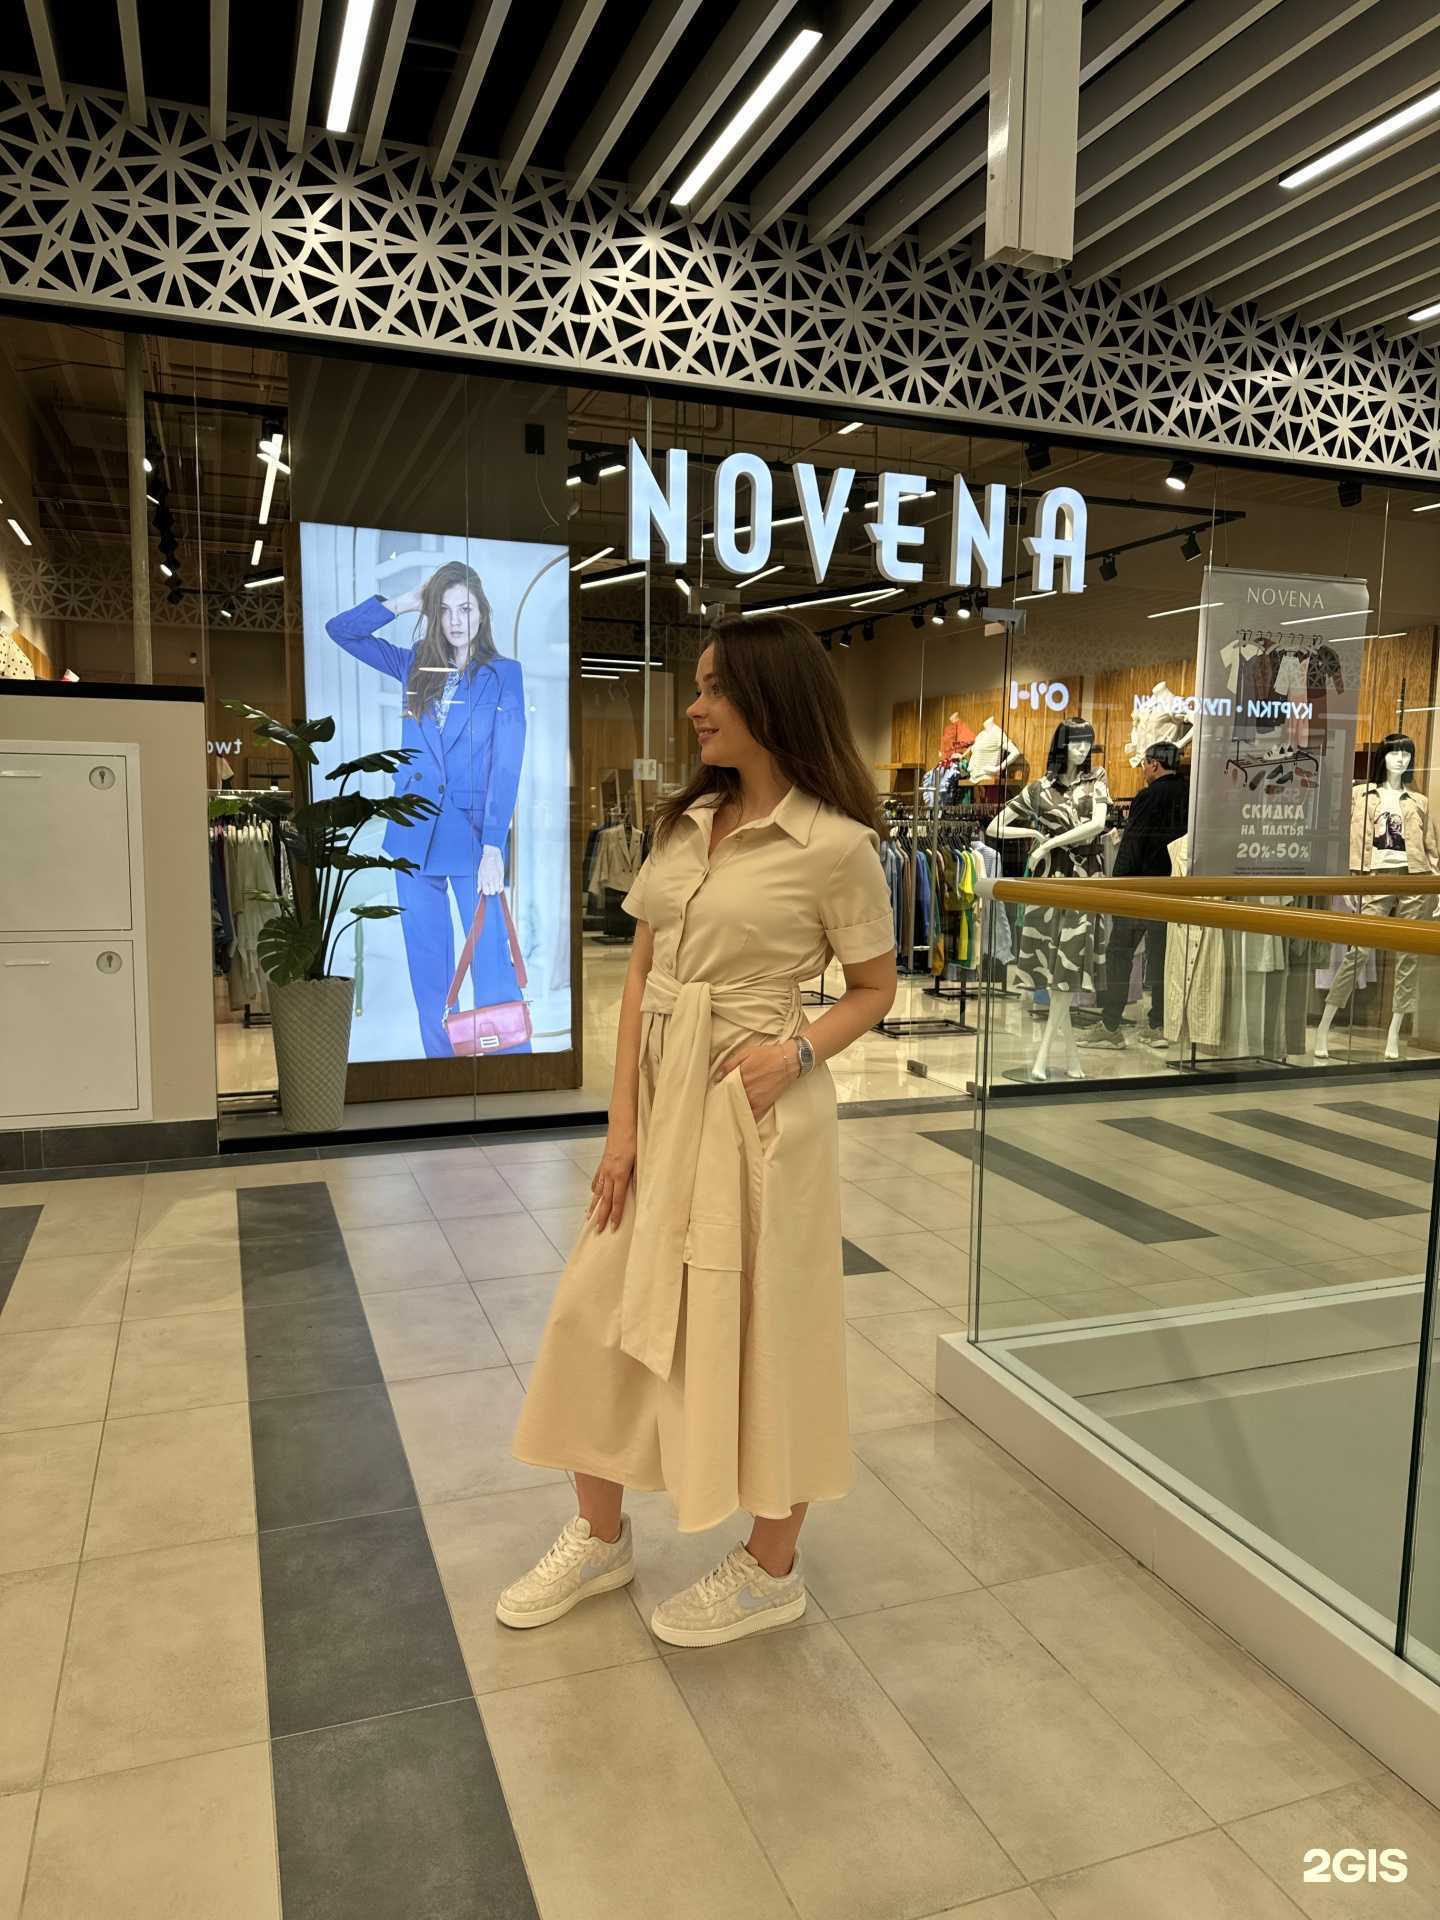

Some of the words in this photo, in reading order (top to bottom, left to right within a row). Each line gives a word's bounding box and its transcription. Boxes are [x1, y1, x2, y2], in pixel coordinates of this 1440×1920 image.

[628, 437, 1088, 594] NOVENA
[1247, 587, 1325, 609] NOVENA
[1241, 803, 1305, 820] СКИДКА
[1241, 824, 1256, 836] НА
